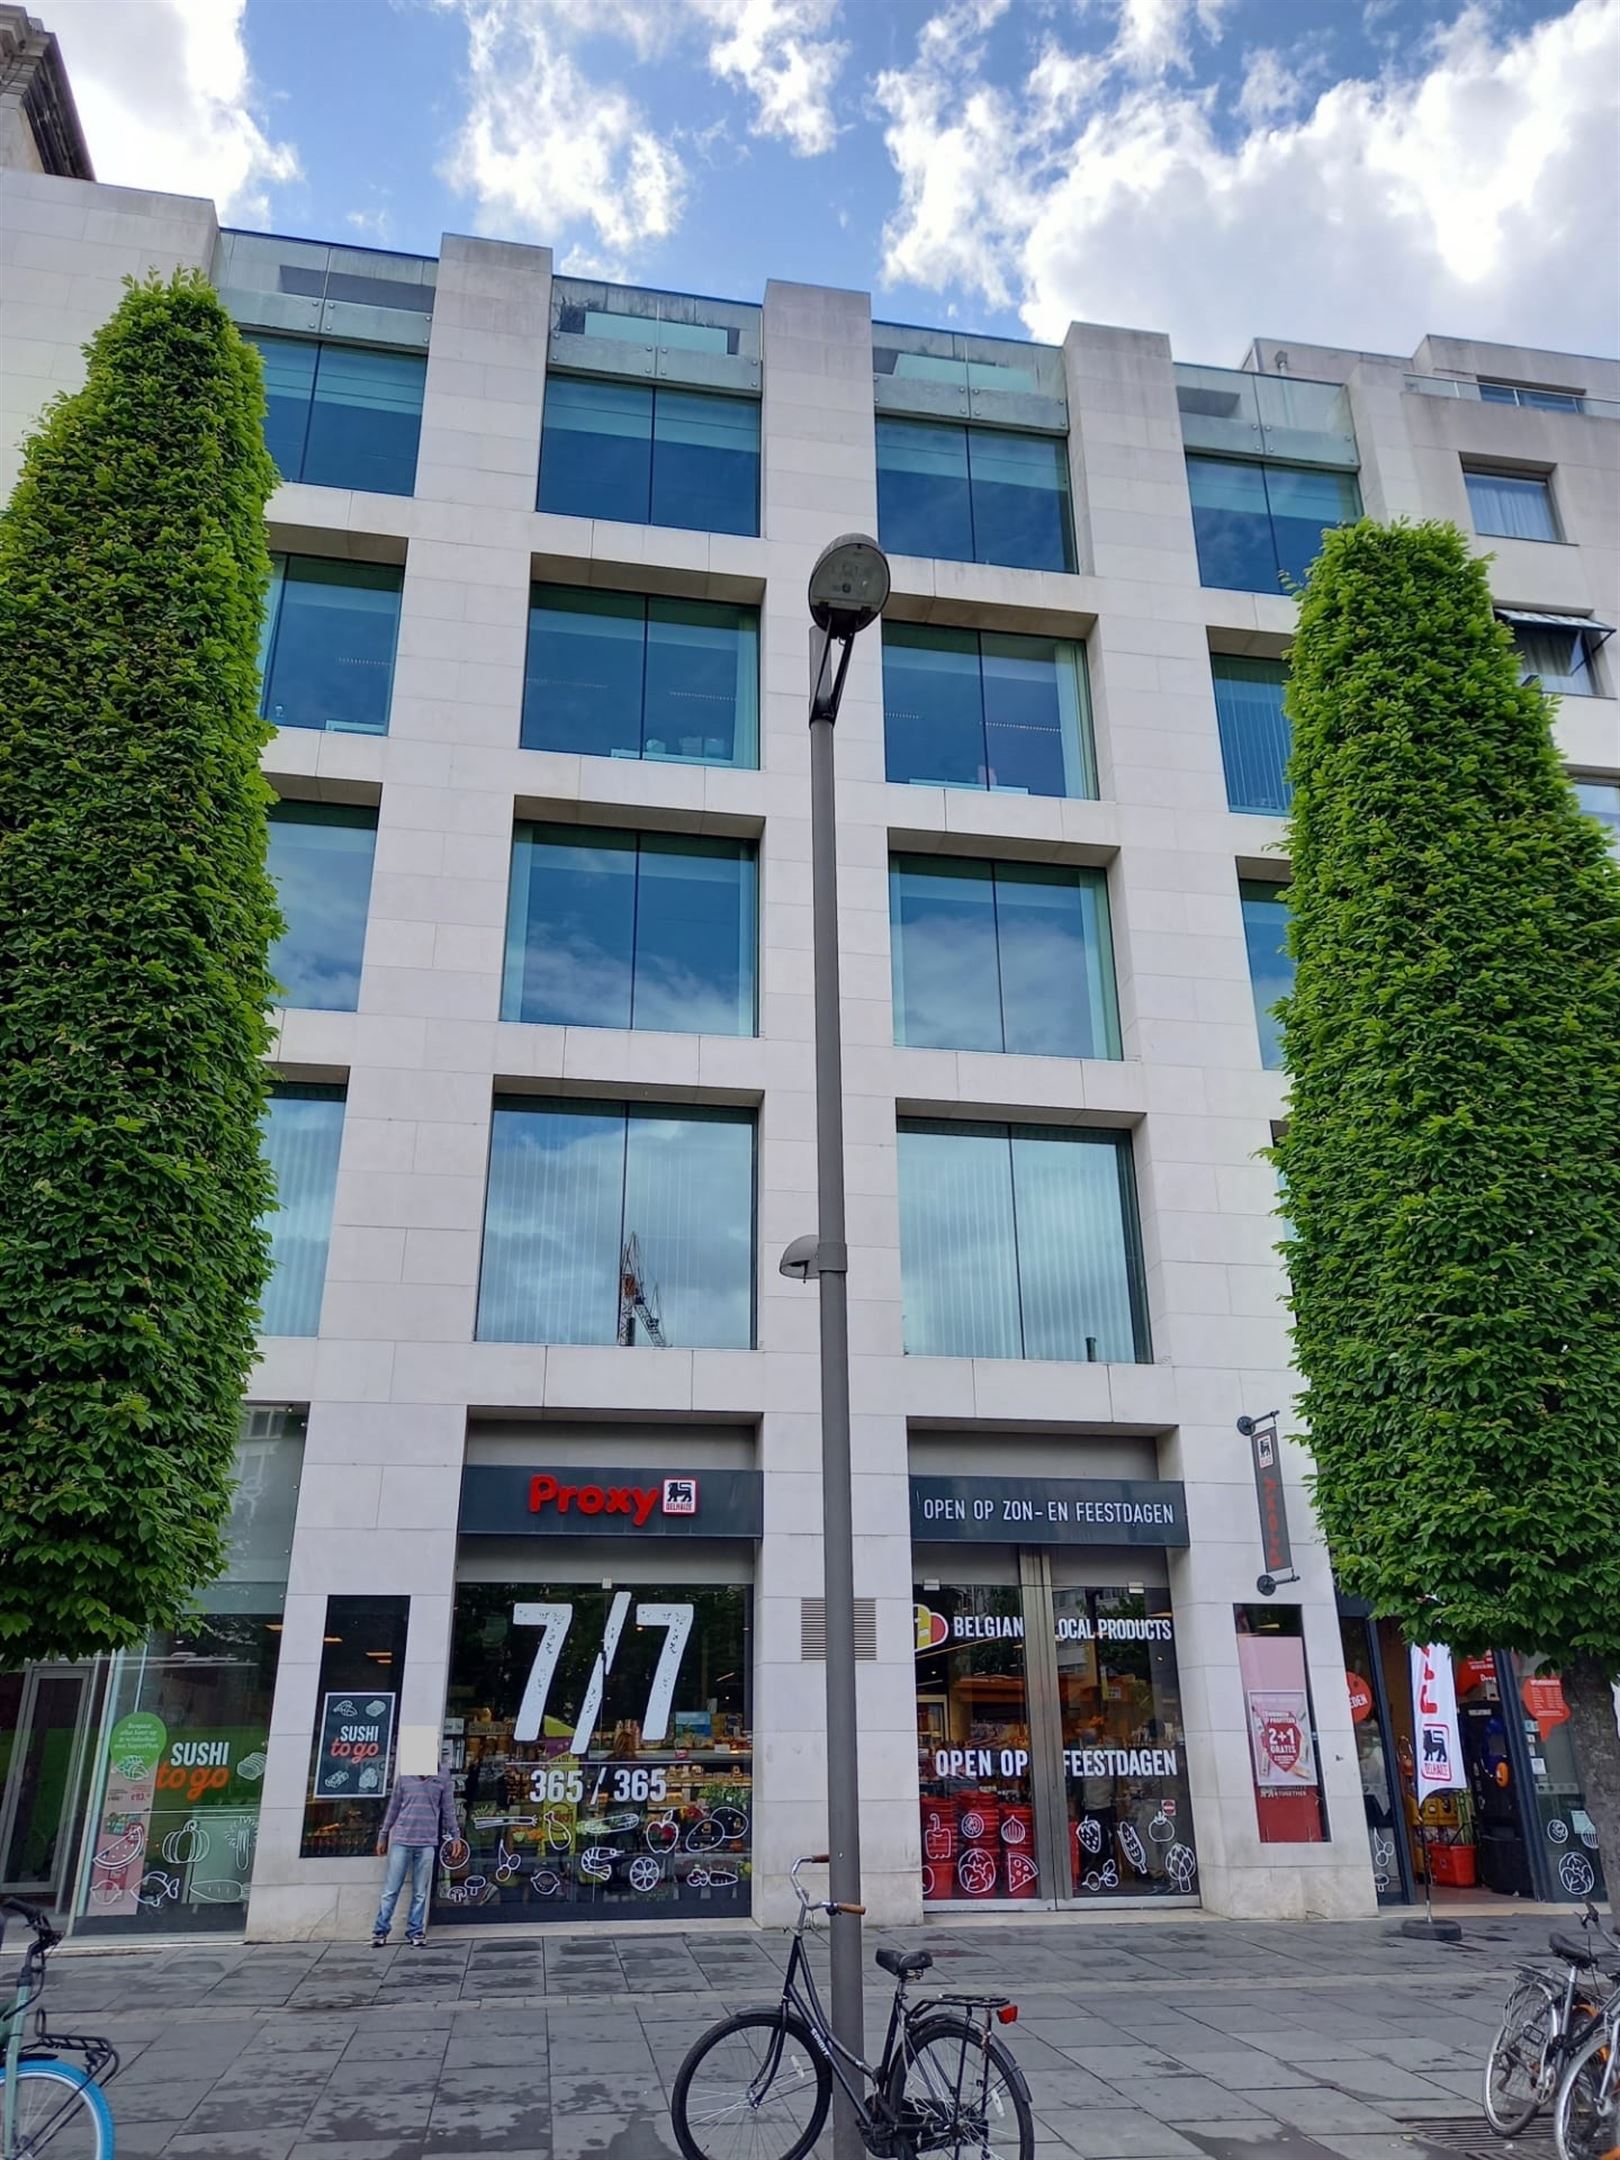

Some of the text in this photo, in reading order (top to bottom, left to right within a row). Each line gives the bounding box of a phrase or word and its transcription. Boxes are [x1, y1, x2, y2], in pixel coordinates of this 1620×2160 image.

[529, 1473, 660, 1527] Proxy
[924, 1499, 1174, 1524] OPEN OP ZON- EN FEESTDAGEN
[953, 1615, 1024, 1638] BELGIAN
[1098, 1618, 1172, 1640] PRODUCTS
[513, 1591, 694, 1754] 7/7
[340, 1725, 379, 1742] SUSHI
[1268, 1727, 1296, 1745] 2+1
[170, 1742, 230, 1766] SUSHI
[331, 1738, 379, 1764] to go
[935, 1750, 993, 1777] OPEN
[1001, 1751, 1028, 1777] OP
[156, 1760, 187, 1790] to
[186, 1766, 230, 1802] go
